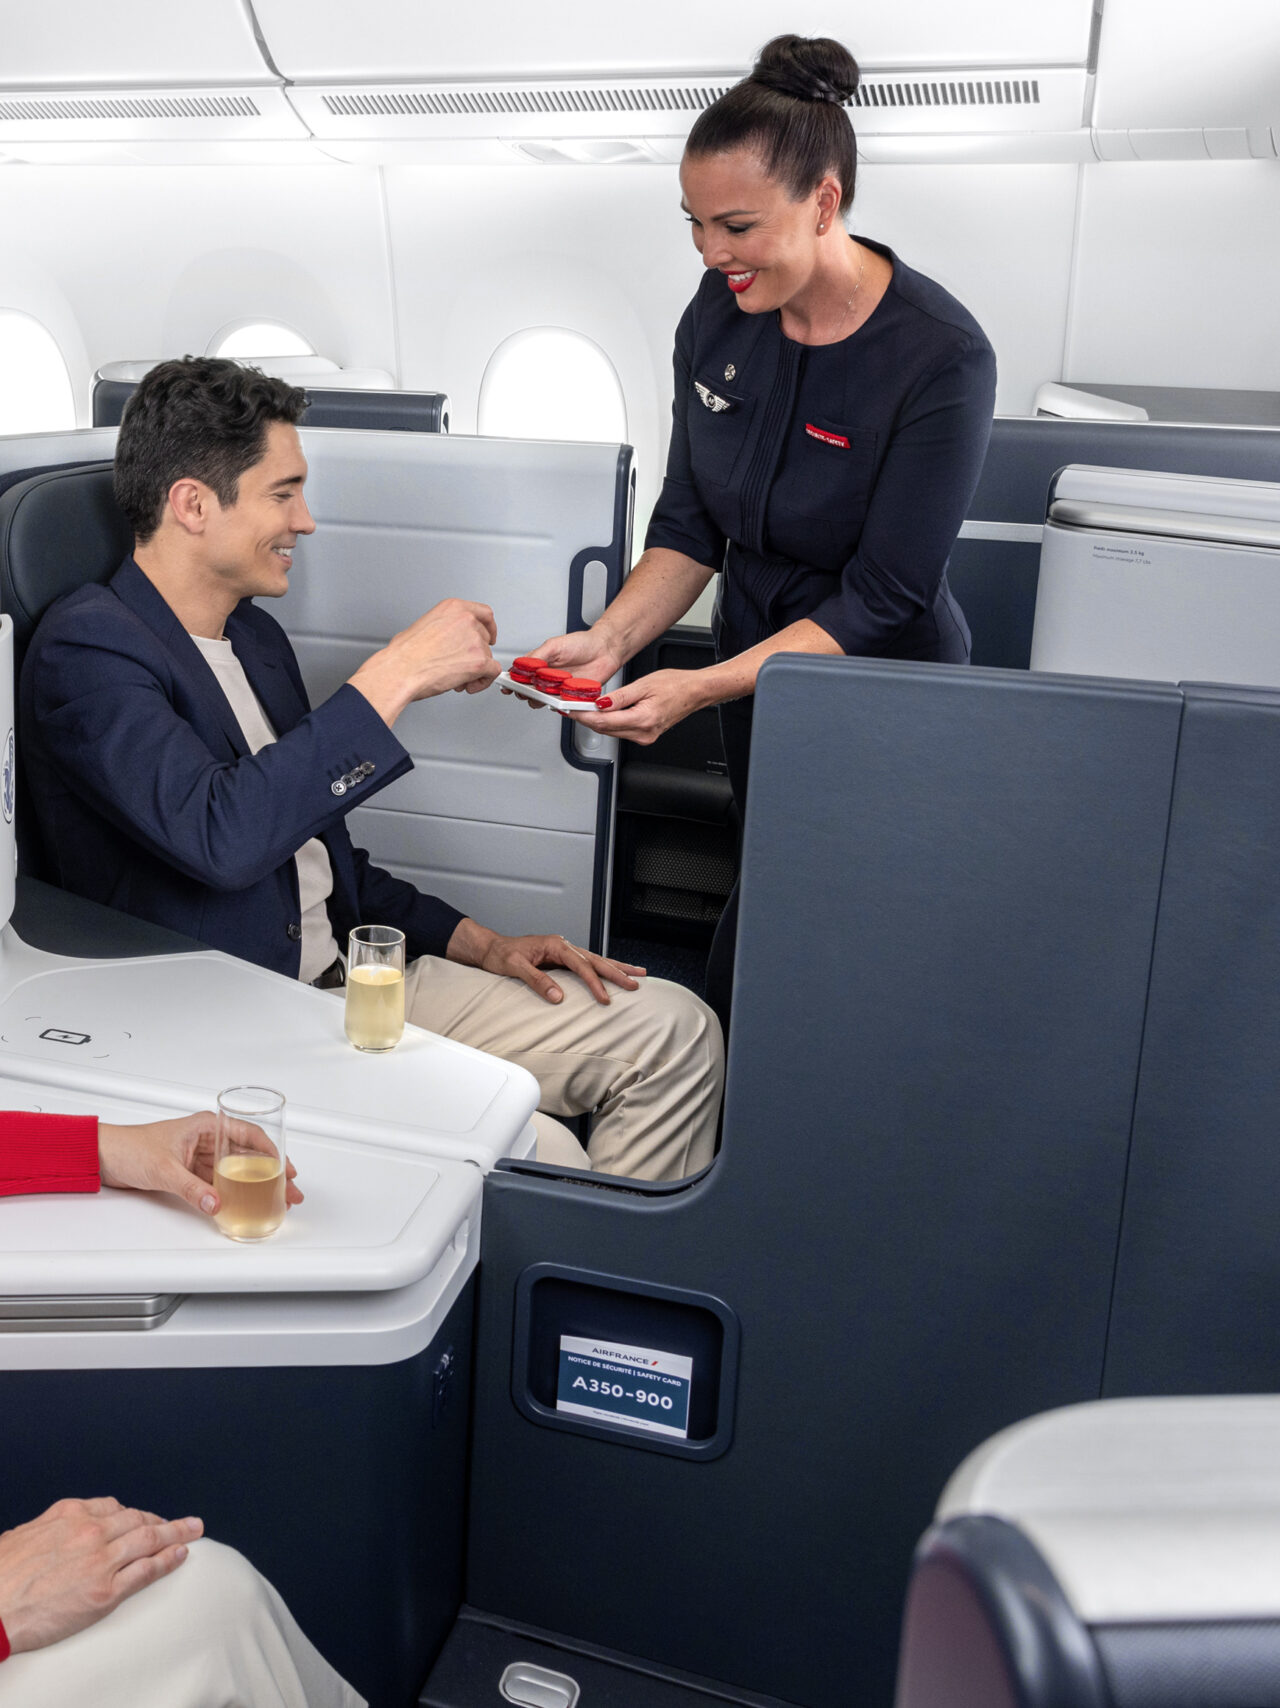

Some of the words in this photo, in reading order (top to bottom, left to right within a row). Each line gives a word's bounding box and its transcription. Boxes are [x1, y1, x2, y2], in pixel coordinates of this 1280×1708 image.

[567, 1355, 592, 1366] NOTICE
[601, 1362, 632, 1375] SÉCURITÉ
[637, 1371, 661, 1381] SAFETY
[662, 1377, 682, 1387] CARD
[591, 1347, 649, 1365] AIRFRANCE
[572, 1376, 673, 1410] A350-900
